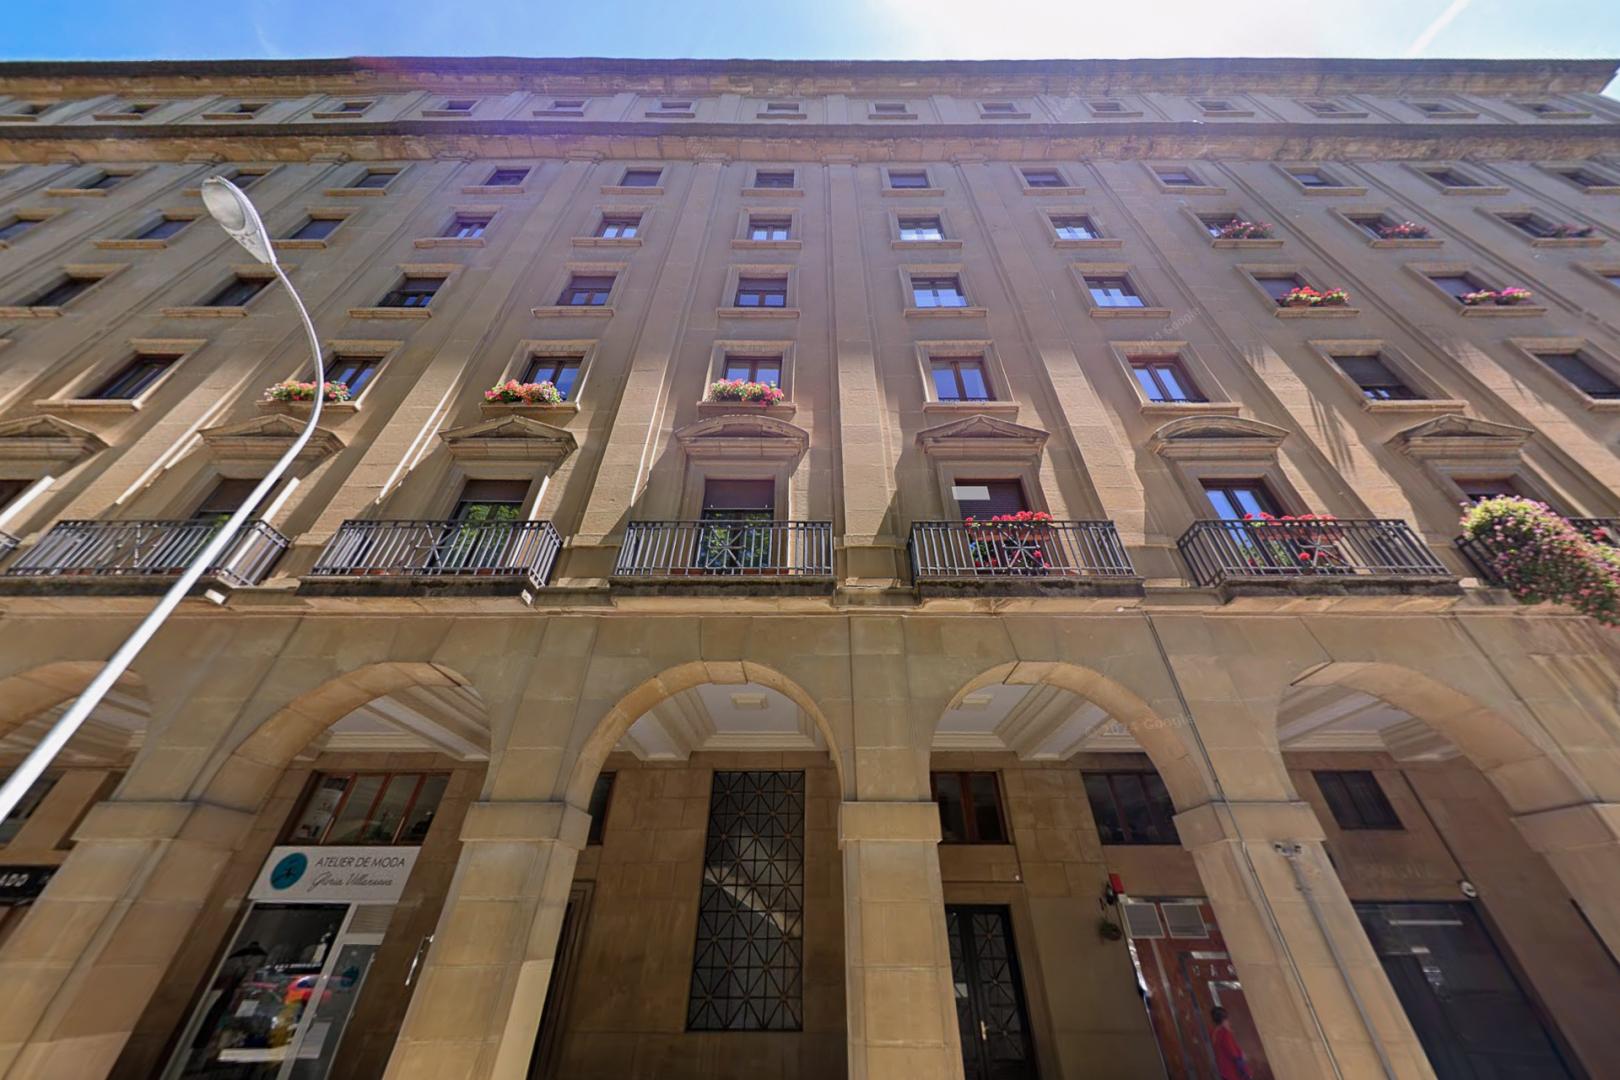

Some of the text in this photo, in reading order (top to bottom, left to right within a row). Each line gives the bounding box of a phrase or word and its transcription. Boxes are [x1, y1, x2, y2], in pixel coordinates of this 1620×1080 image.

[315, 857, 405, 868] ATELIER DE MODA
